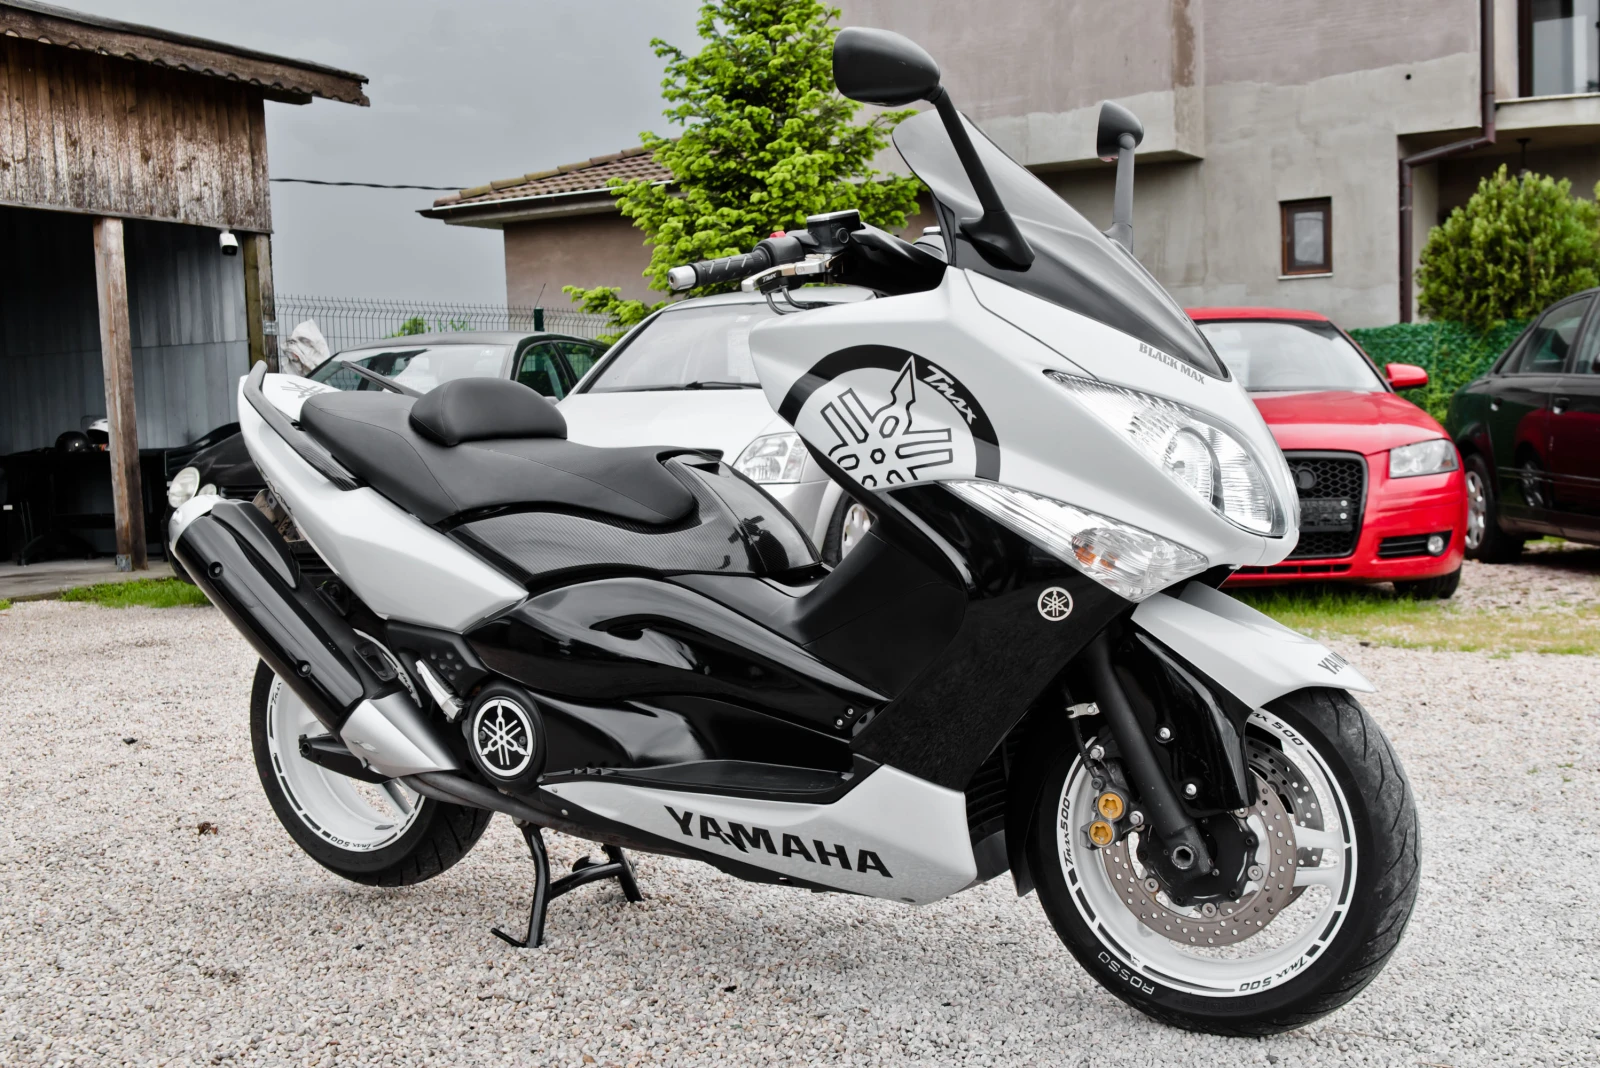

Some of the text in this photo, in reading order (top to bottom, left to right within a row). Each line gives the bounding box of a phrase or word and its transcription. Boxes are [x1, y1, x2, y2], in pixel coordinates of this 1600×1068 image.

[1139, 342, 1205, 385] BLACK MAX
[1271, 721, 1304, 746] 500
[1060, 797, 1070, 832] 500
[330, 836, 350, 848] 500
[663, 804, 894, 879] YAMAHA
[1097, 951, 1155, 995] ROSSO
[1239, 976, 1272, 992] 500
